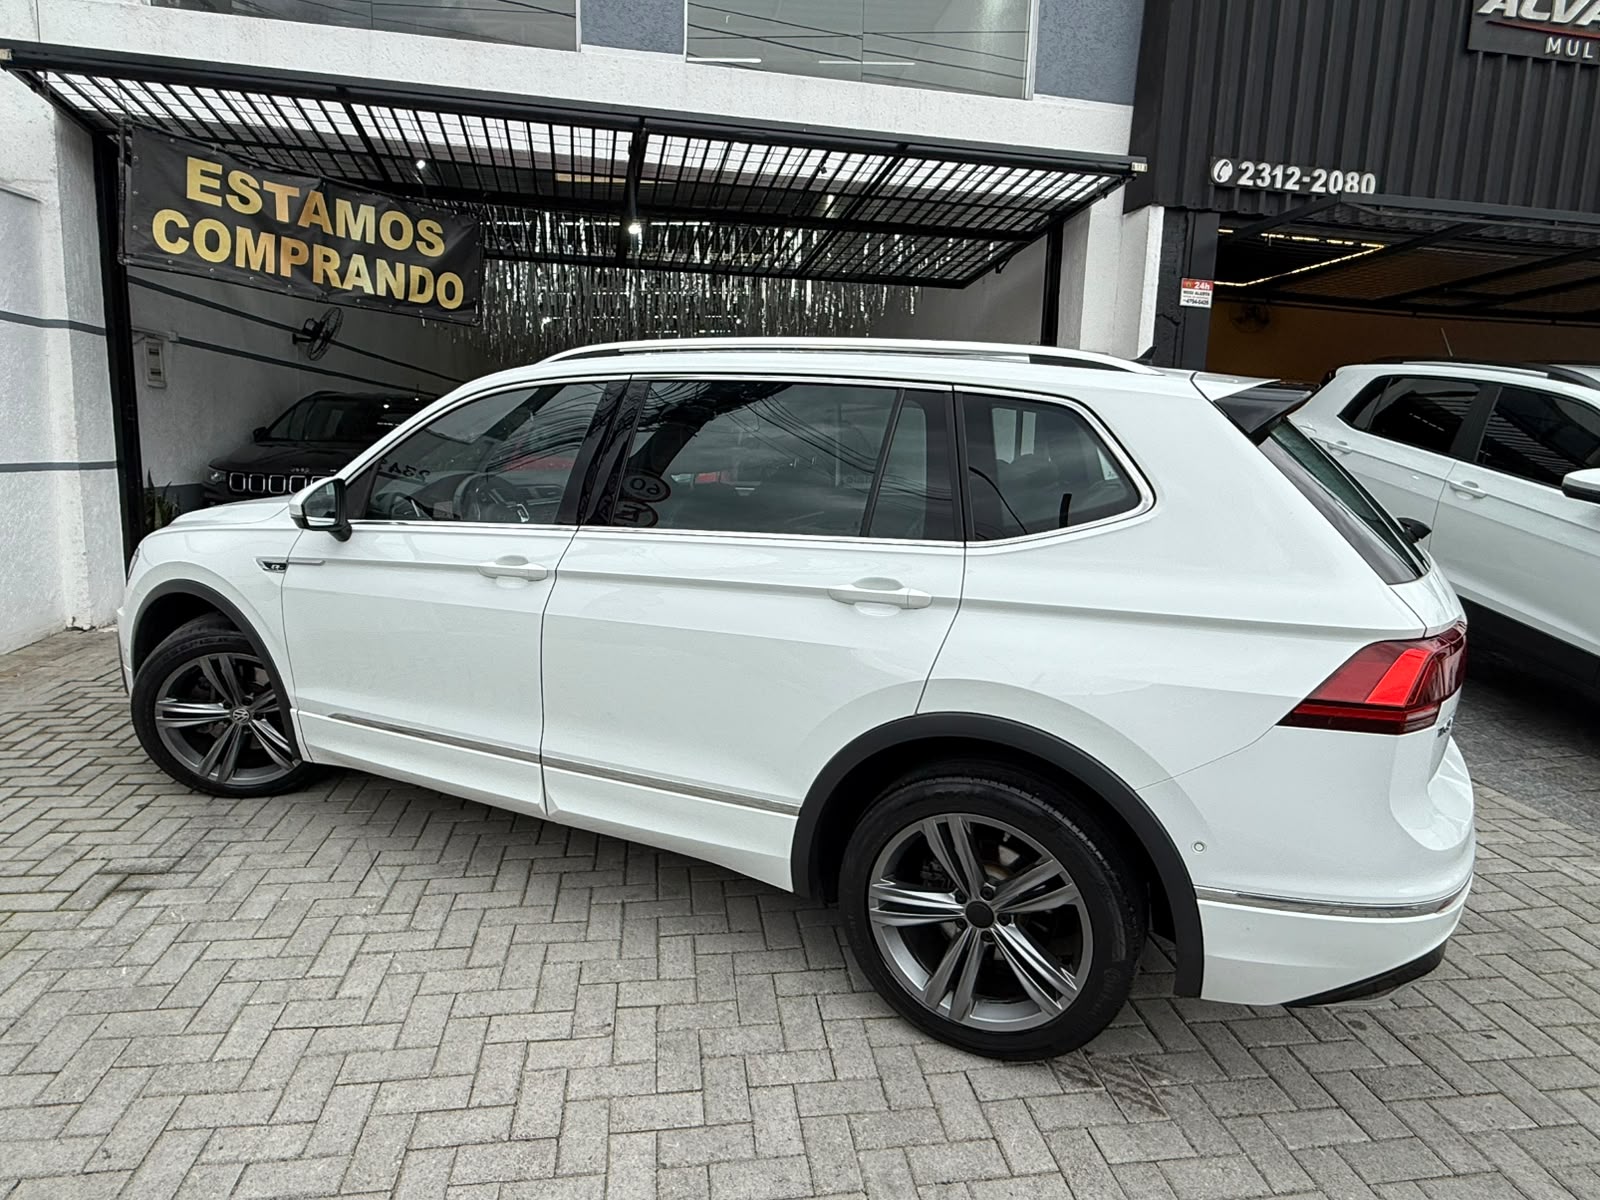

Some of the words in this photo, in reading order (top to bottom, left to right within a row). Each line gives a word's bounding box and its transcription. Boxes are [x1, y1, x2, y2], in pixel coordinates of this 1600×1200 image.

[186, 156, 446, 258] ESTAMOS
[1236, 160, 1377, 194] 2312-2080
[151, 208, 465, 310] COMPRANDO
[1194, 282, 1210, 290] 24h
